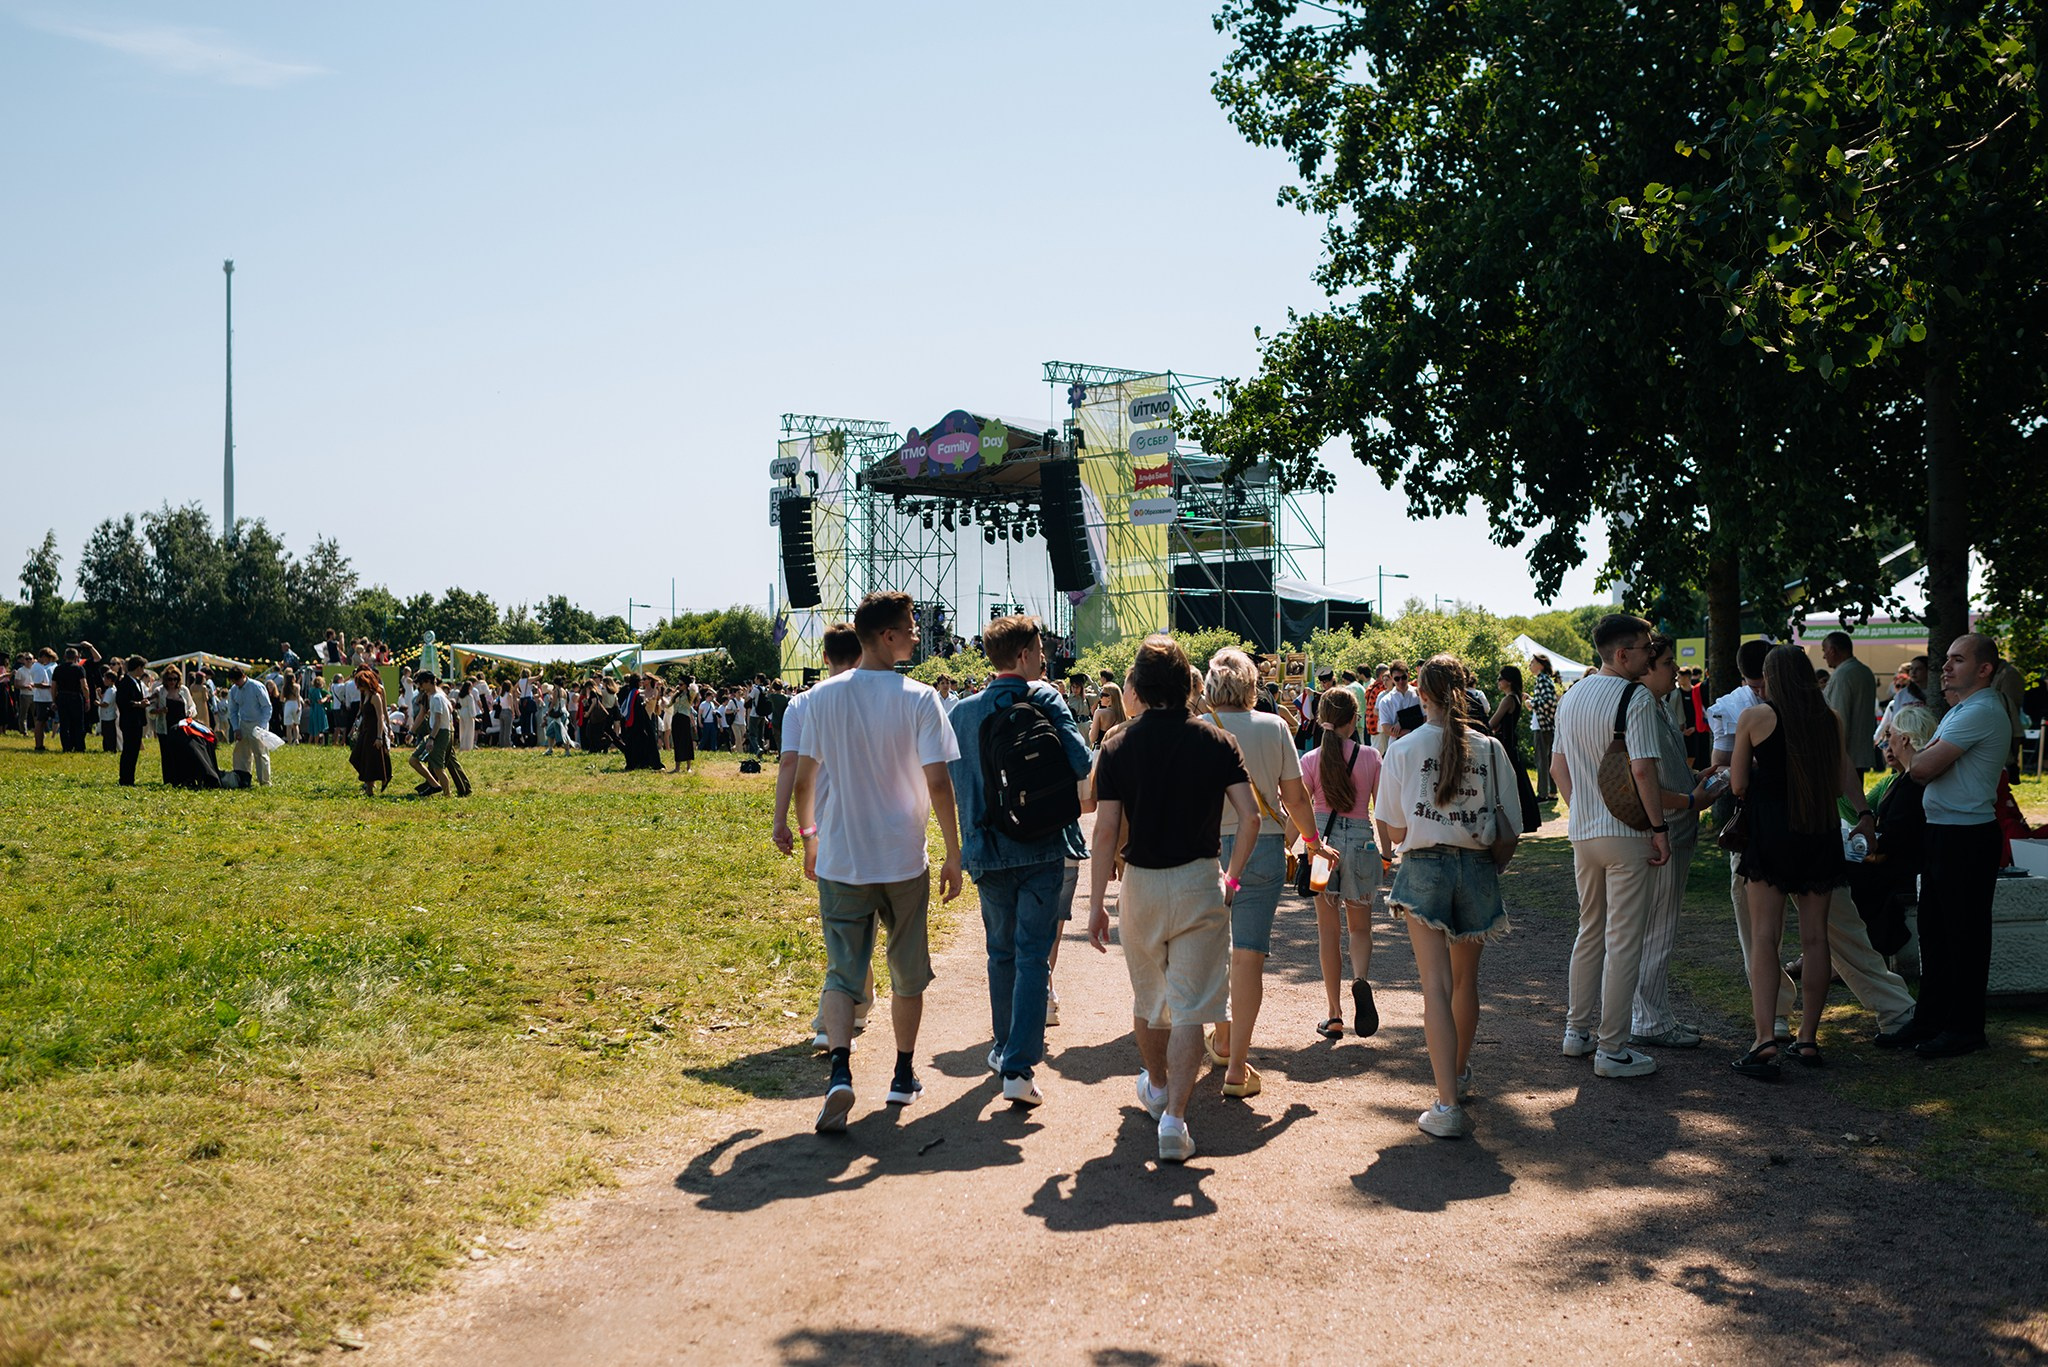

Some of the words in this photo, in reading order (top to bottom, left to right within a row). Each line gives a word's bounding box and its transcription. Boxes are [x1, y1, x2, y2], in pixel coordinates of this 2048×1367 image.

[901, 446, 926, 460] ITMO
[937, 440, 971, 455] Family
[983, 435, 1004, 449] Day
[1147, 434, 1169, 447] СБЕР
